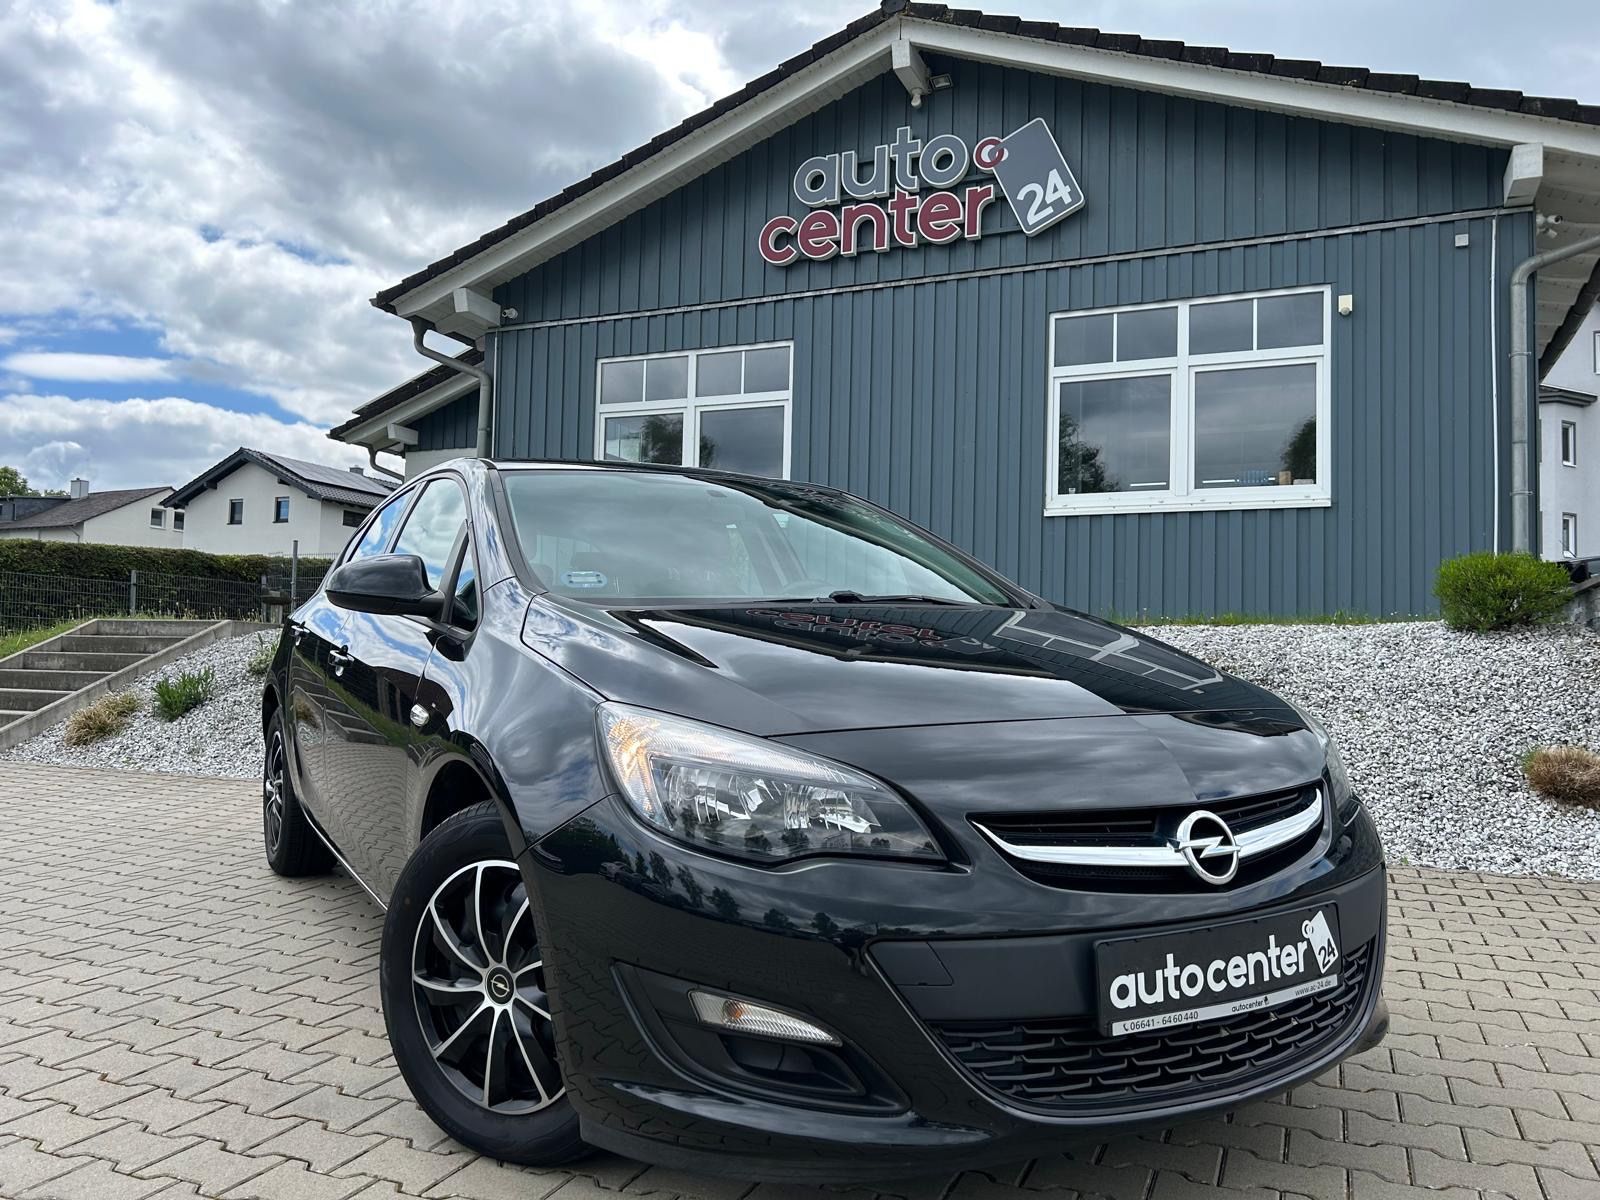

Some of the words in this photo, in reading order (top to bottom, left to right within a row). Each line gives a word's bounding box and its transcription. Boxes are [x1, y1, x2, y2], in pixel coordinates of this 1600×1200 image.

[793, 126, 969, 207] auto
[1017, 169, 1073, 225] 24
[758, 183, 994, 266] center
[1109, 934, 1307, 1009] autocenter
[1318, 938, 1335, 969] 24
[1130, 1018, 1154, 1030] 06641
[1231, 999, 1263, 1012] autocenter
